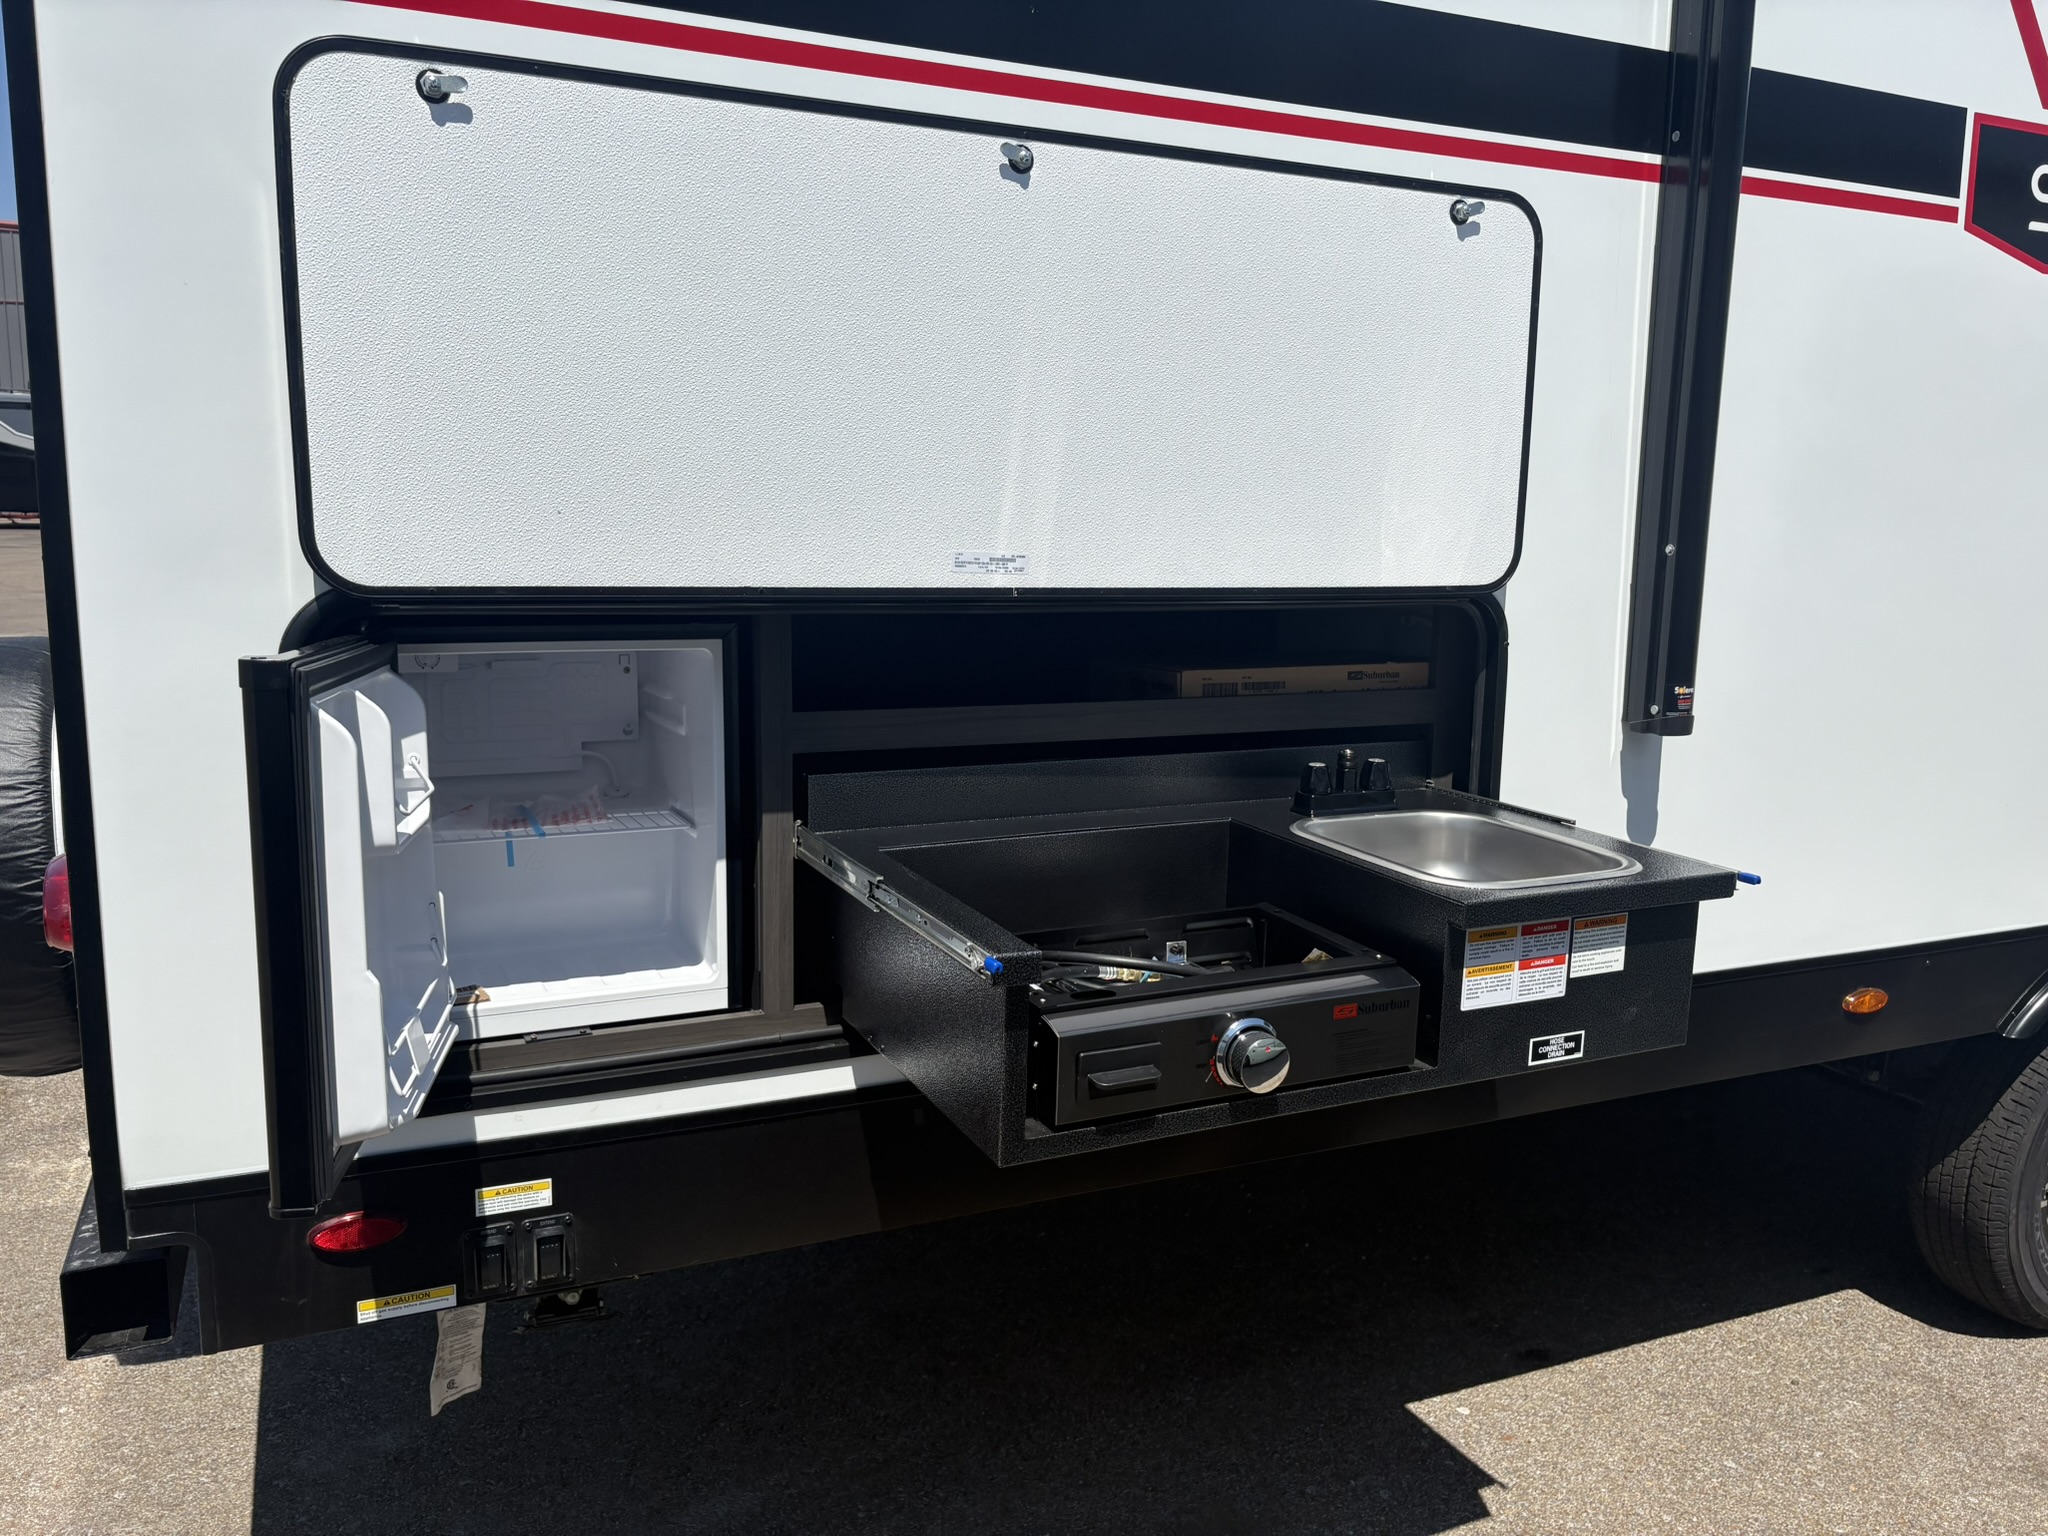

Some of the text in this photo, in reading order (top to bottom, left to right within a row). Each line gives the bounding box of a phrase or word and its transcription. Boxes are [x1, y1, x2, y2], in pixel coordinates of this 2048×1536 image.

[1364, 671, 1399, 679] Suburban
[1590, 918, 1617, 926] WARNING
[1535, 958, 1554, 966] DANGER
[1472, 964, 1512, 973] AVERTISSEMENT
[1359, 1000, 1410, 1014] Suburban
[1539, 1041, 1575, 1053] CONNECTION
[1548, 1050, 1565, 1058] DRAIN
[502, 1186, 534, 1194] CAUTION
[391, 1292, 430, 1303] CAUTION
